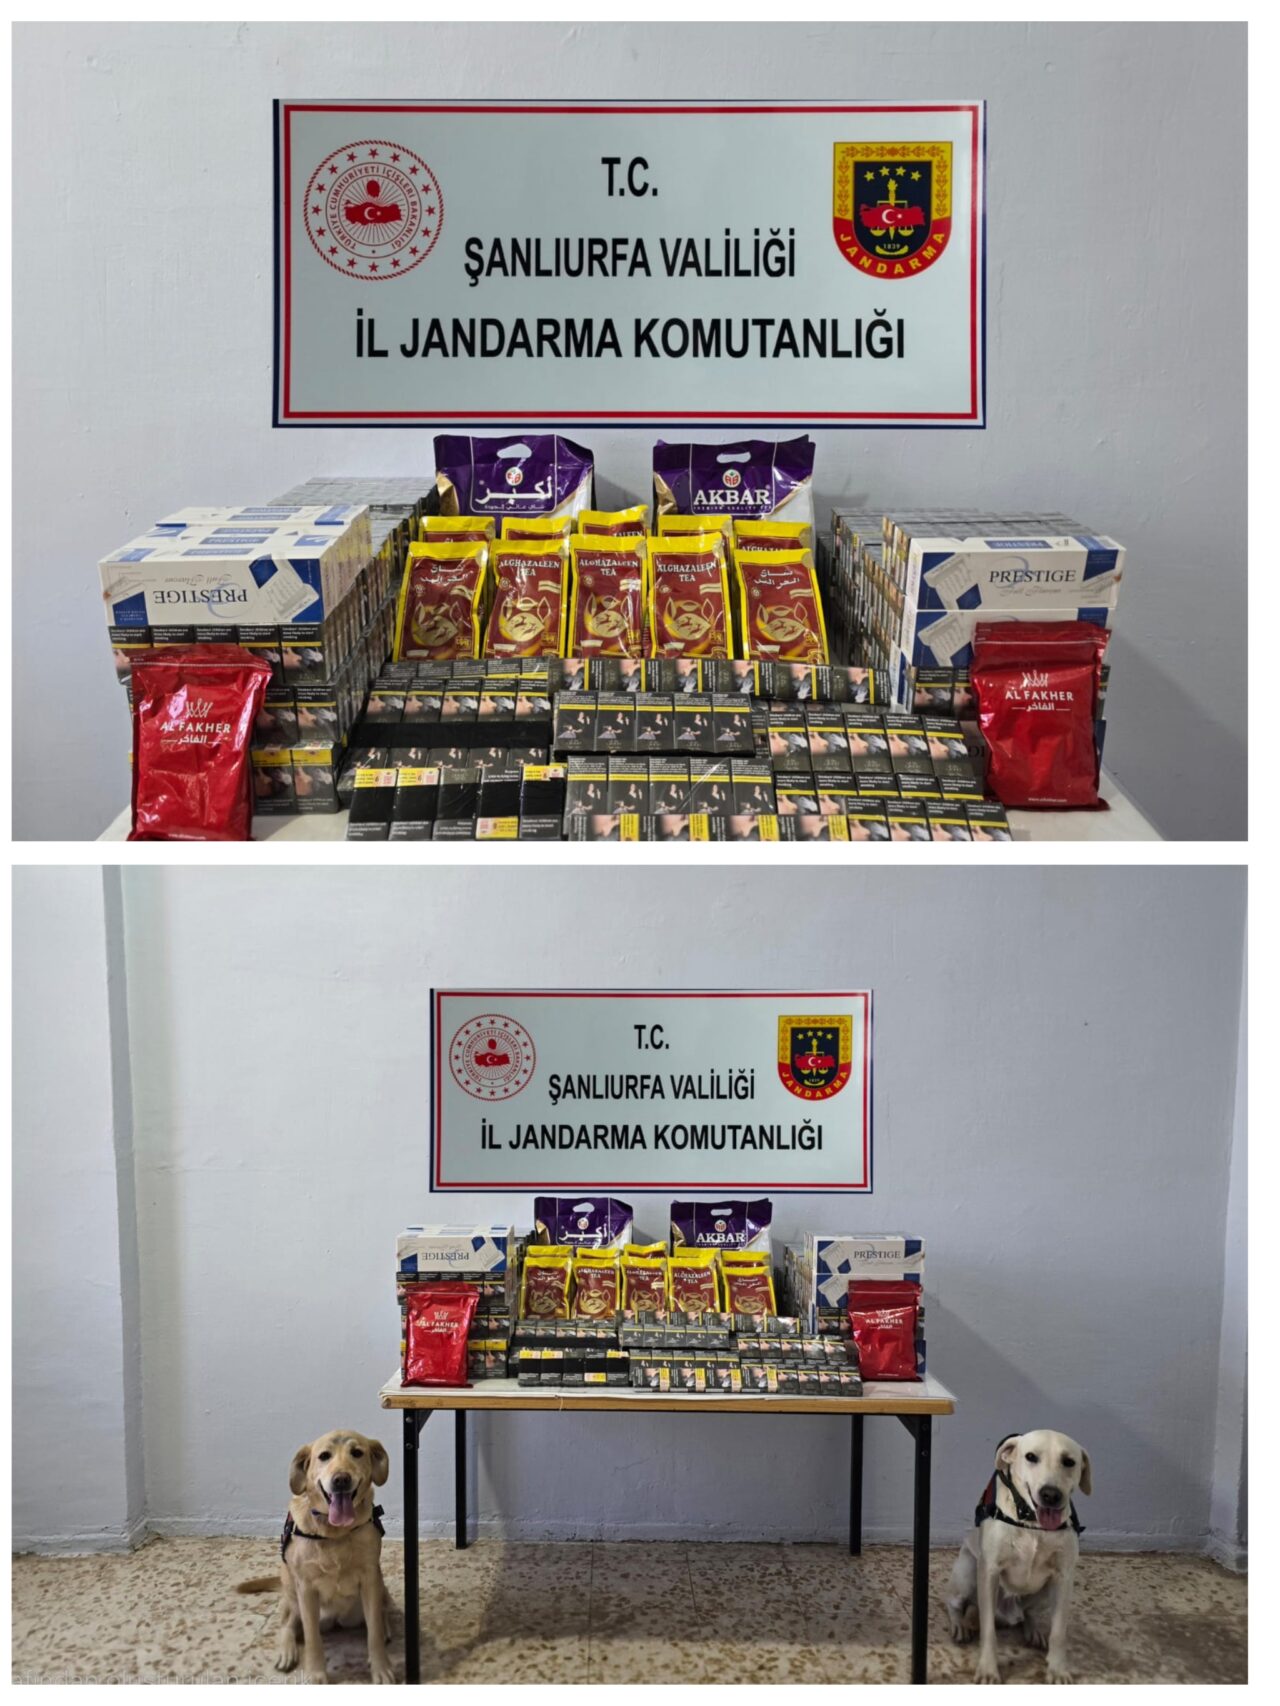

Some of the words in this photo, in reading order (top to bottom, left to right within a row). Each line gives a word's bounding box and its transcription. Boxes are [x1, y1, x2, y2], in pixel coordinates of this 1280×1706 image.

[329, 164, 380, 211] CUMHURİYETİ
[382, 166, 415, 199] İÇİŞLERİ
[601, 157, 657, 197] T.C.
[329, 213, 357, 250] TÜRKİYE
[391, 200, 418, 250] BAKANLIĞI
[465, 237, 651, 287] ŞANLIURFA
[660, 228, 794, 277] VALİLİĞİ
[840, 233, 945, 275] JANDARMA
[357, 308, 388, 357] İL
[400, 318, 622, 358] JANDARMA
[635, 309, 903, 358] KOMUTANLIĞI
[693, 489, 772, 505] AKBAR
[518, 568, 536, 577] TEA
[601, 568, 616, 576] TEA
[679, 574, 696, 582] TEA
[989, 570, 1075, 583] PRESTIGE
[153, 589, 248, 604] PRESTIGE
[1005, 691, 1020, 700] AL
[1024, 691, 1074, 701] FAKHER
[160, 722, 174, 731] AL
[179, 722, 231, 733] FAKHER
[634, 1024, 669, 1049] T.C.
[549, 1074, 665, 1105] ŞANLIURFA
[670, 1069, 754, 1099] VALİLİĞİ
[782, 1072, 847, 1098] JANDARMA
[482, 1118, 501, 1149] İL
[509, 1125, 647, 1149] JANDARMA
[655, 1119, 822, 1150] KOMUTANLIĞI
[696, 1233, 745, 1243] AKBAR
[422, 1252, 469, 1260] PRESTIGE
